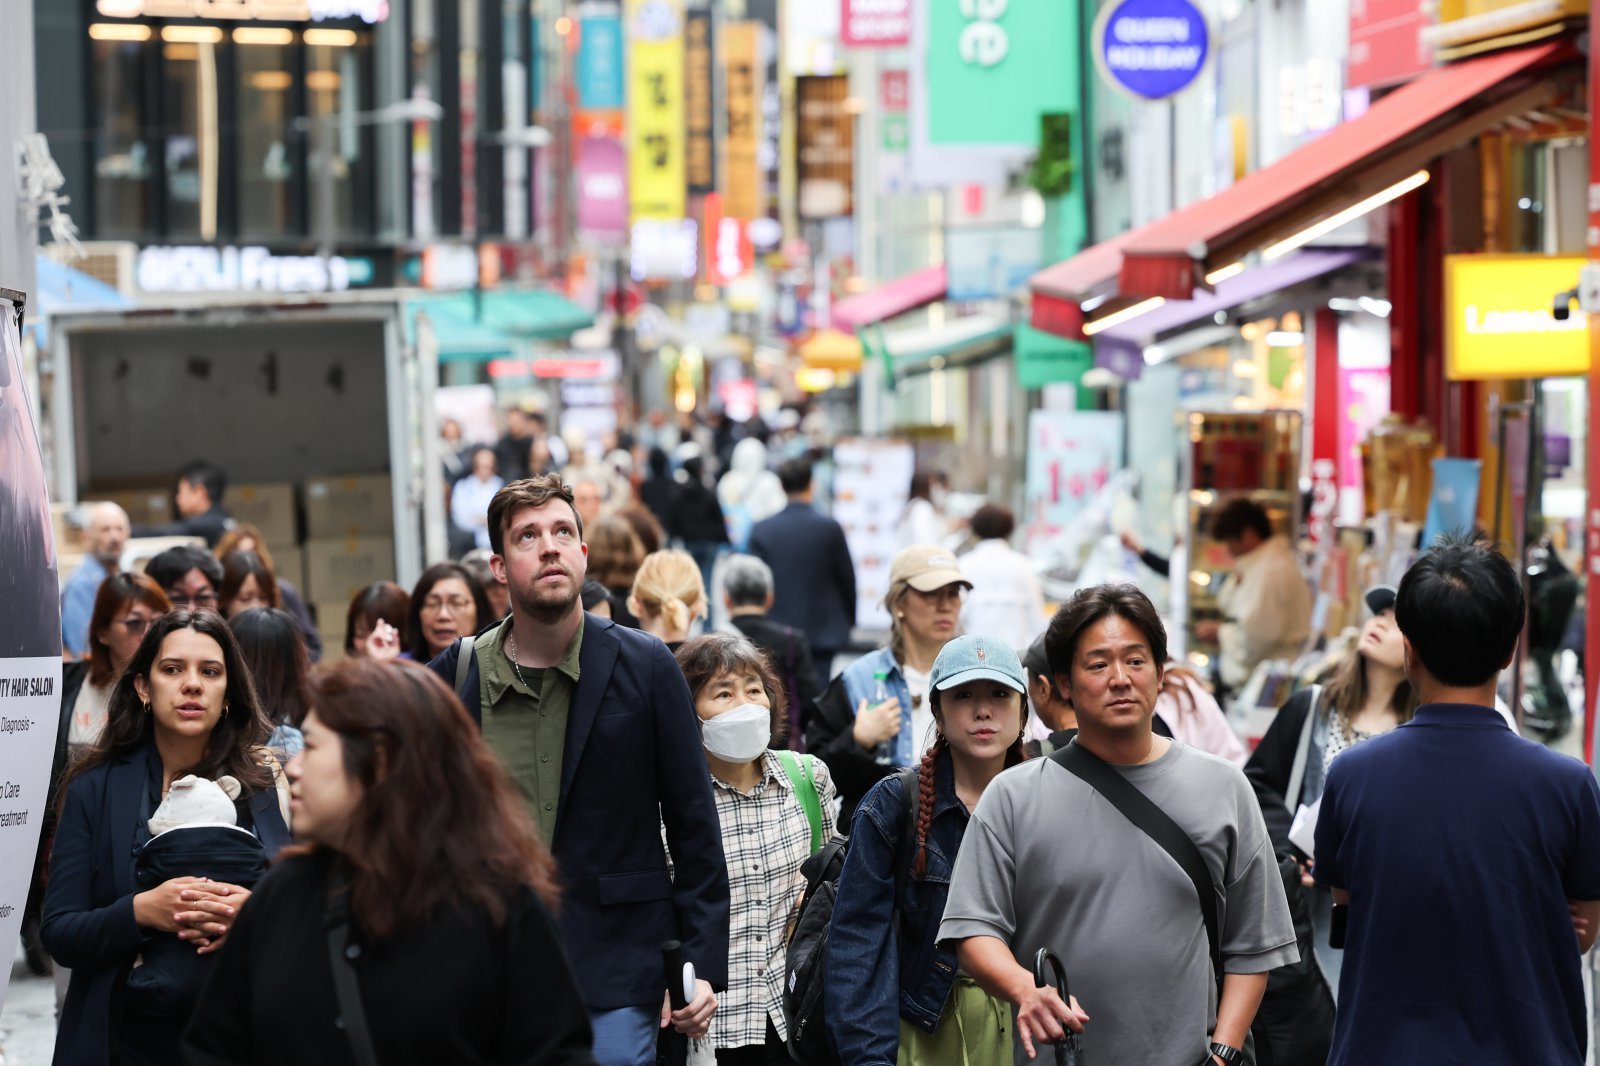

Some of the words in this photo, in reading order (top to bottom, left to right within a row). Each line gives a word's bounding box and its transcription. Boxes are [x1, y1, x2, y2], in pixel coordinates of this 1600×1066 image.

[1114, 17, 1190, 43] QUEEN
[1107, 45, 1201, 70] HOLIDAY
[11, 678, 29, 697] HAIR
[30, 677, 54, 696] SALON
[1, 716, 29, 734] Diagnosis
[5, 781, 20, 798] Care
